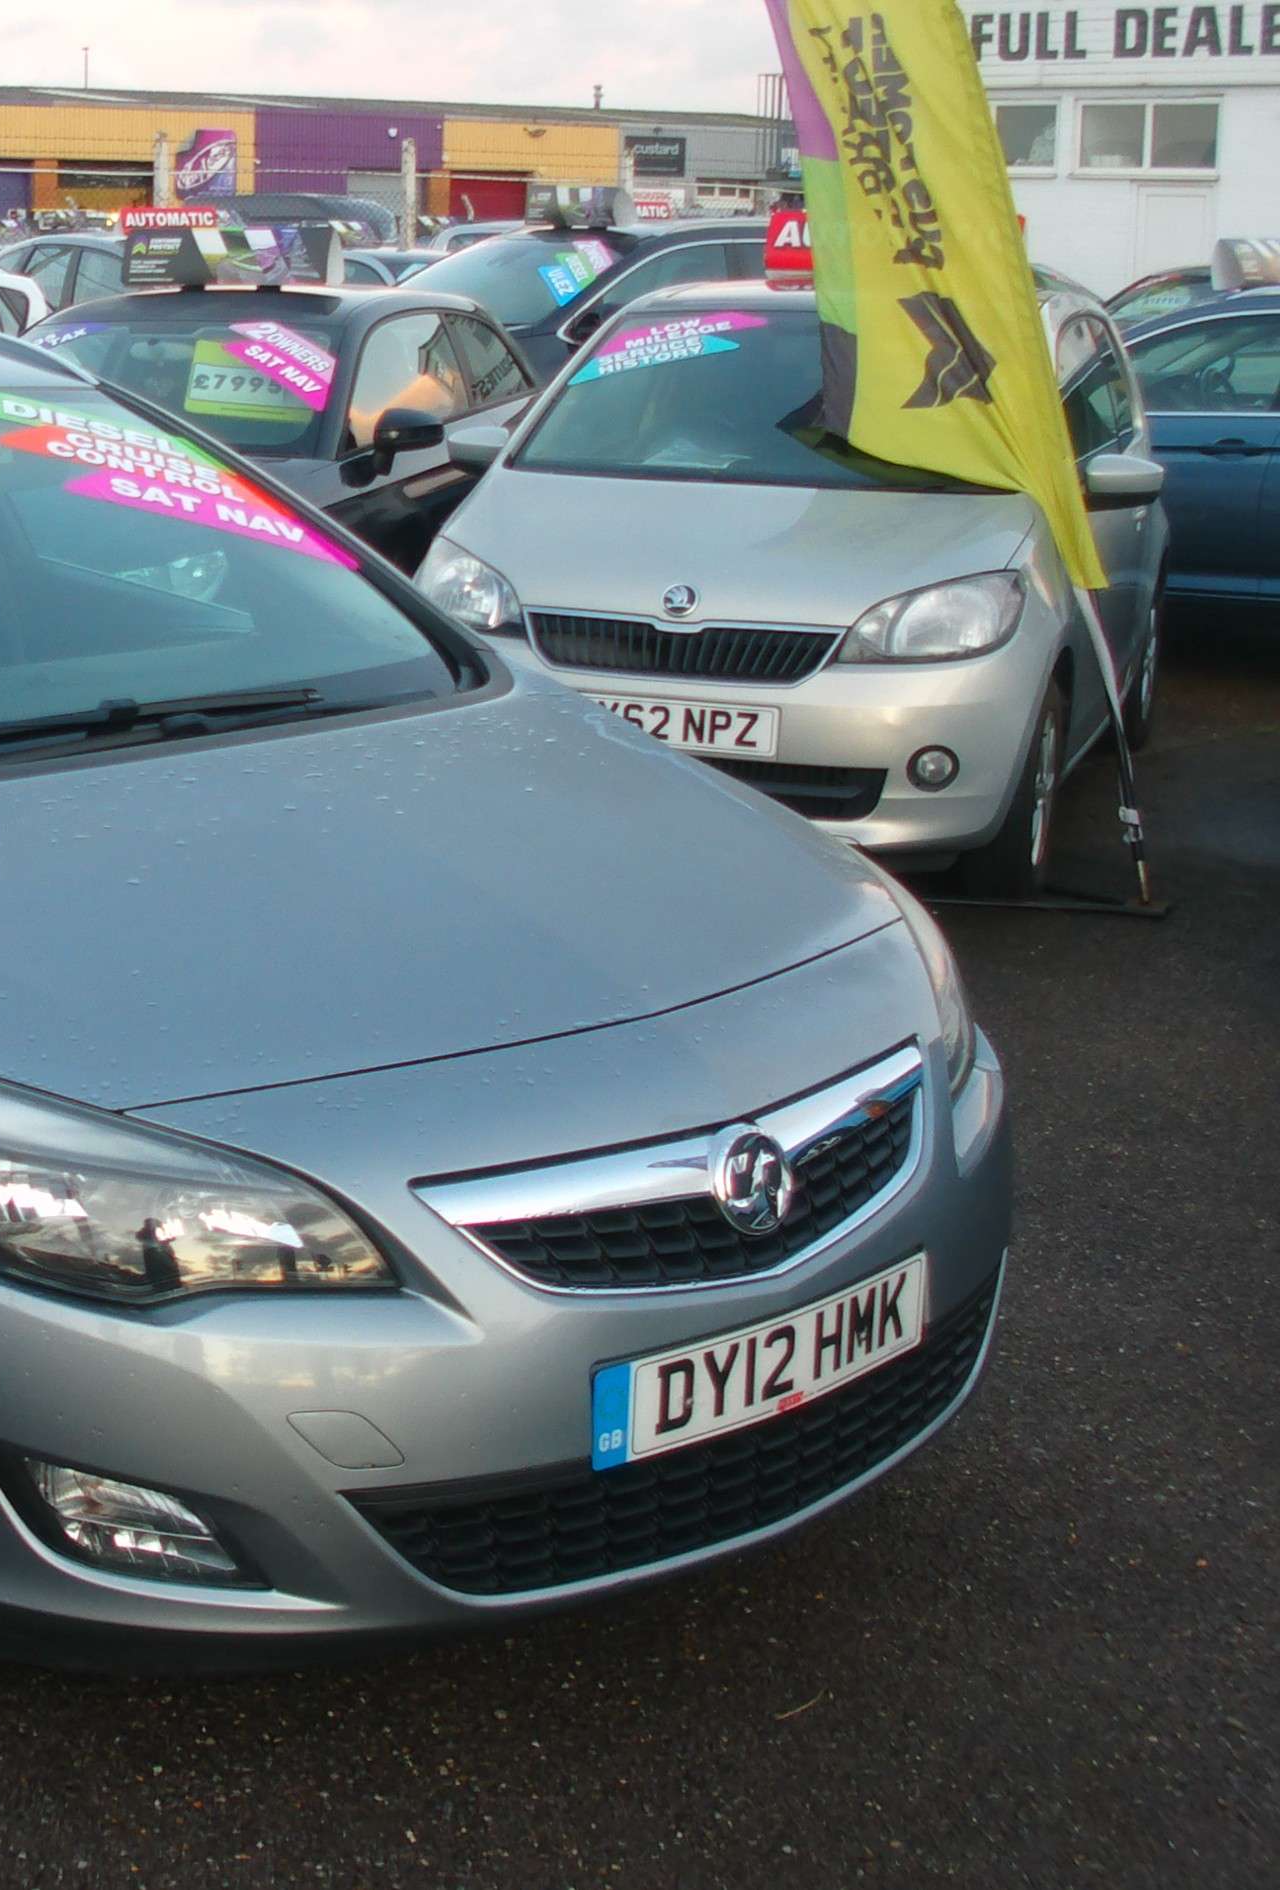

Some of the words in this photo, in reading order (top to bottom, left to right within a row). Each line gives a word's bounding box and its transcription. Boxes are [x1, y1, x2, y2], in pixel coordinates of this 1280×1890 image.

[971, 10, 1087, 62] FULL
[1113, 4, 1280, 60] DEALE
[634, 142, 679, 155] custard
[125, 211, 215, 227] AUTOMATIC
[624, 321, 733, 350] MILEAGE
[650, 318, 702, 336] LOW
[243, 345, 282, 369] SAT
[279, 363, 322, 394] NAV
[597, 336, 702, 365] SERVICE
[598, 346, 703, 376] HISTORY
[193, 373, 282, 395] £7995
[1, 399, 188, 459] DIESEL
[46, 441, 246, 503] CONTROL
[65, 434, 220, 481] CRUISE
[110, 478, 202, 514] SAT
[217, 503, 305, 543] NAV
[599, 700, 670, 740] 52
[682, 707, 759, 747] NPZ
[655, 1325, 796, 1435] DY12
[813, 1272, 907, 1381] HMK
[599, 1428, 623, 1453] GB
